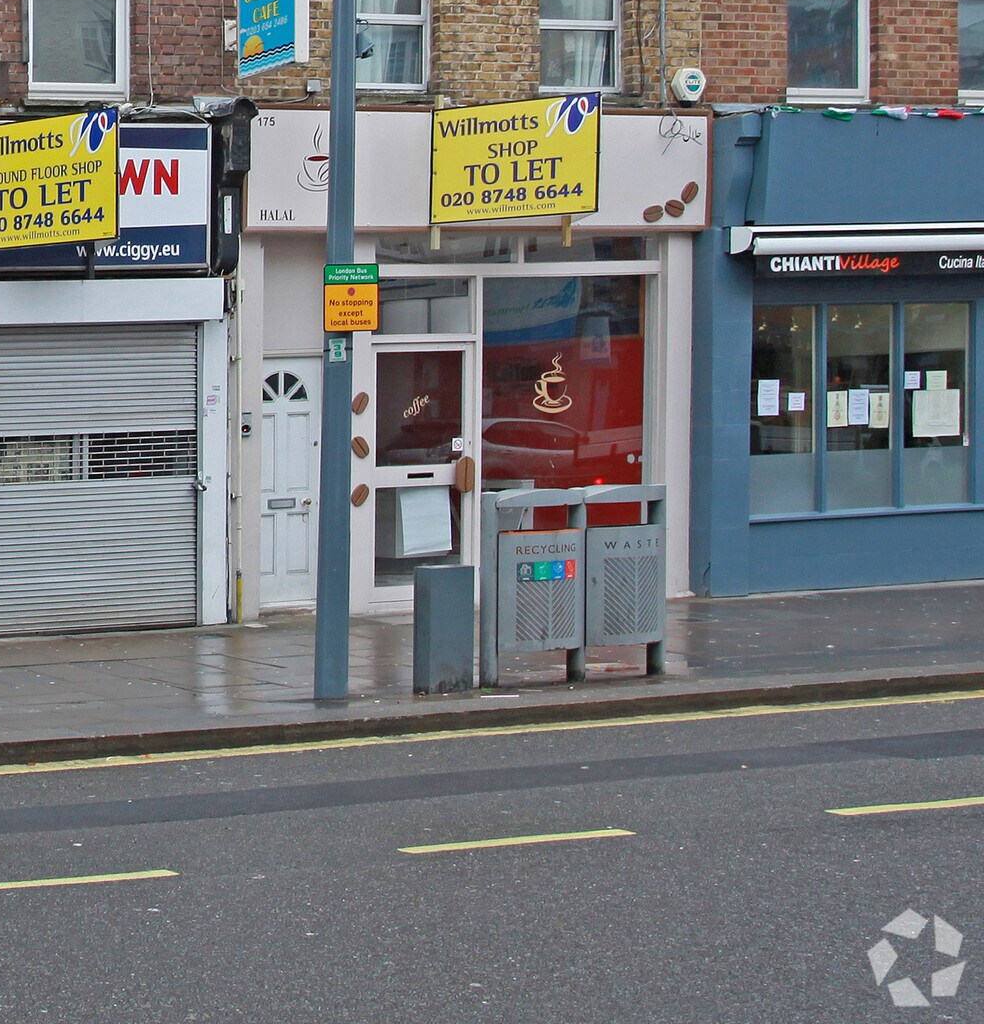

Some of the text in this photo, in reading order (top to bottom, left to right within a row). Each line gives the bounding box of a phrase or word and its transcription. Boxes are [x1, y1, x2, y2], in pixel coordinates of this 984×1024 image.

[252, 0, 279, 24] CAFE
[258, 117, 275, 127] 175
[438, 114, 539, 138] Willmotts
[487, 139, 538, 159] SHOP
[31, 164, 68, 181] FLOOR
[72, 159, 102, 176] SHOP
[464, 157, 563, 186] TO LET
[38, 179, 92, 207] LET
[441, 182, 583, 207] 020 8748 6644
[13, 211, 54, 231] 8748
[60, 206, 105, 226] 6644
[259, 209, 295, 221] HALAL
[466, 202, 556, 215] www.willmotts.com
[0, 228, 80, 243] www.willmotts.com
[770, 253, 900, 273] CHIANTI Village
[939, 255, 973, 269] Cucina
[341, 299, 373, 307] stopping
[403, 394, 430, 419] coffee
[516, 542, 576, 555] RECYCLING
[604, 538, 660, 550] WASTE
